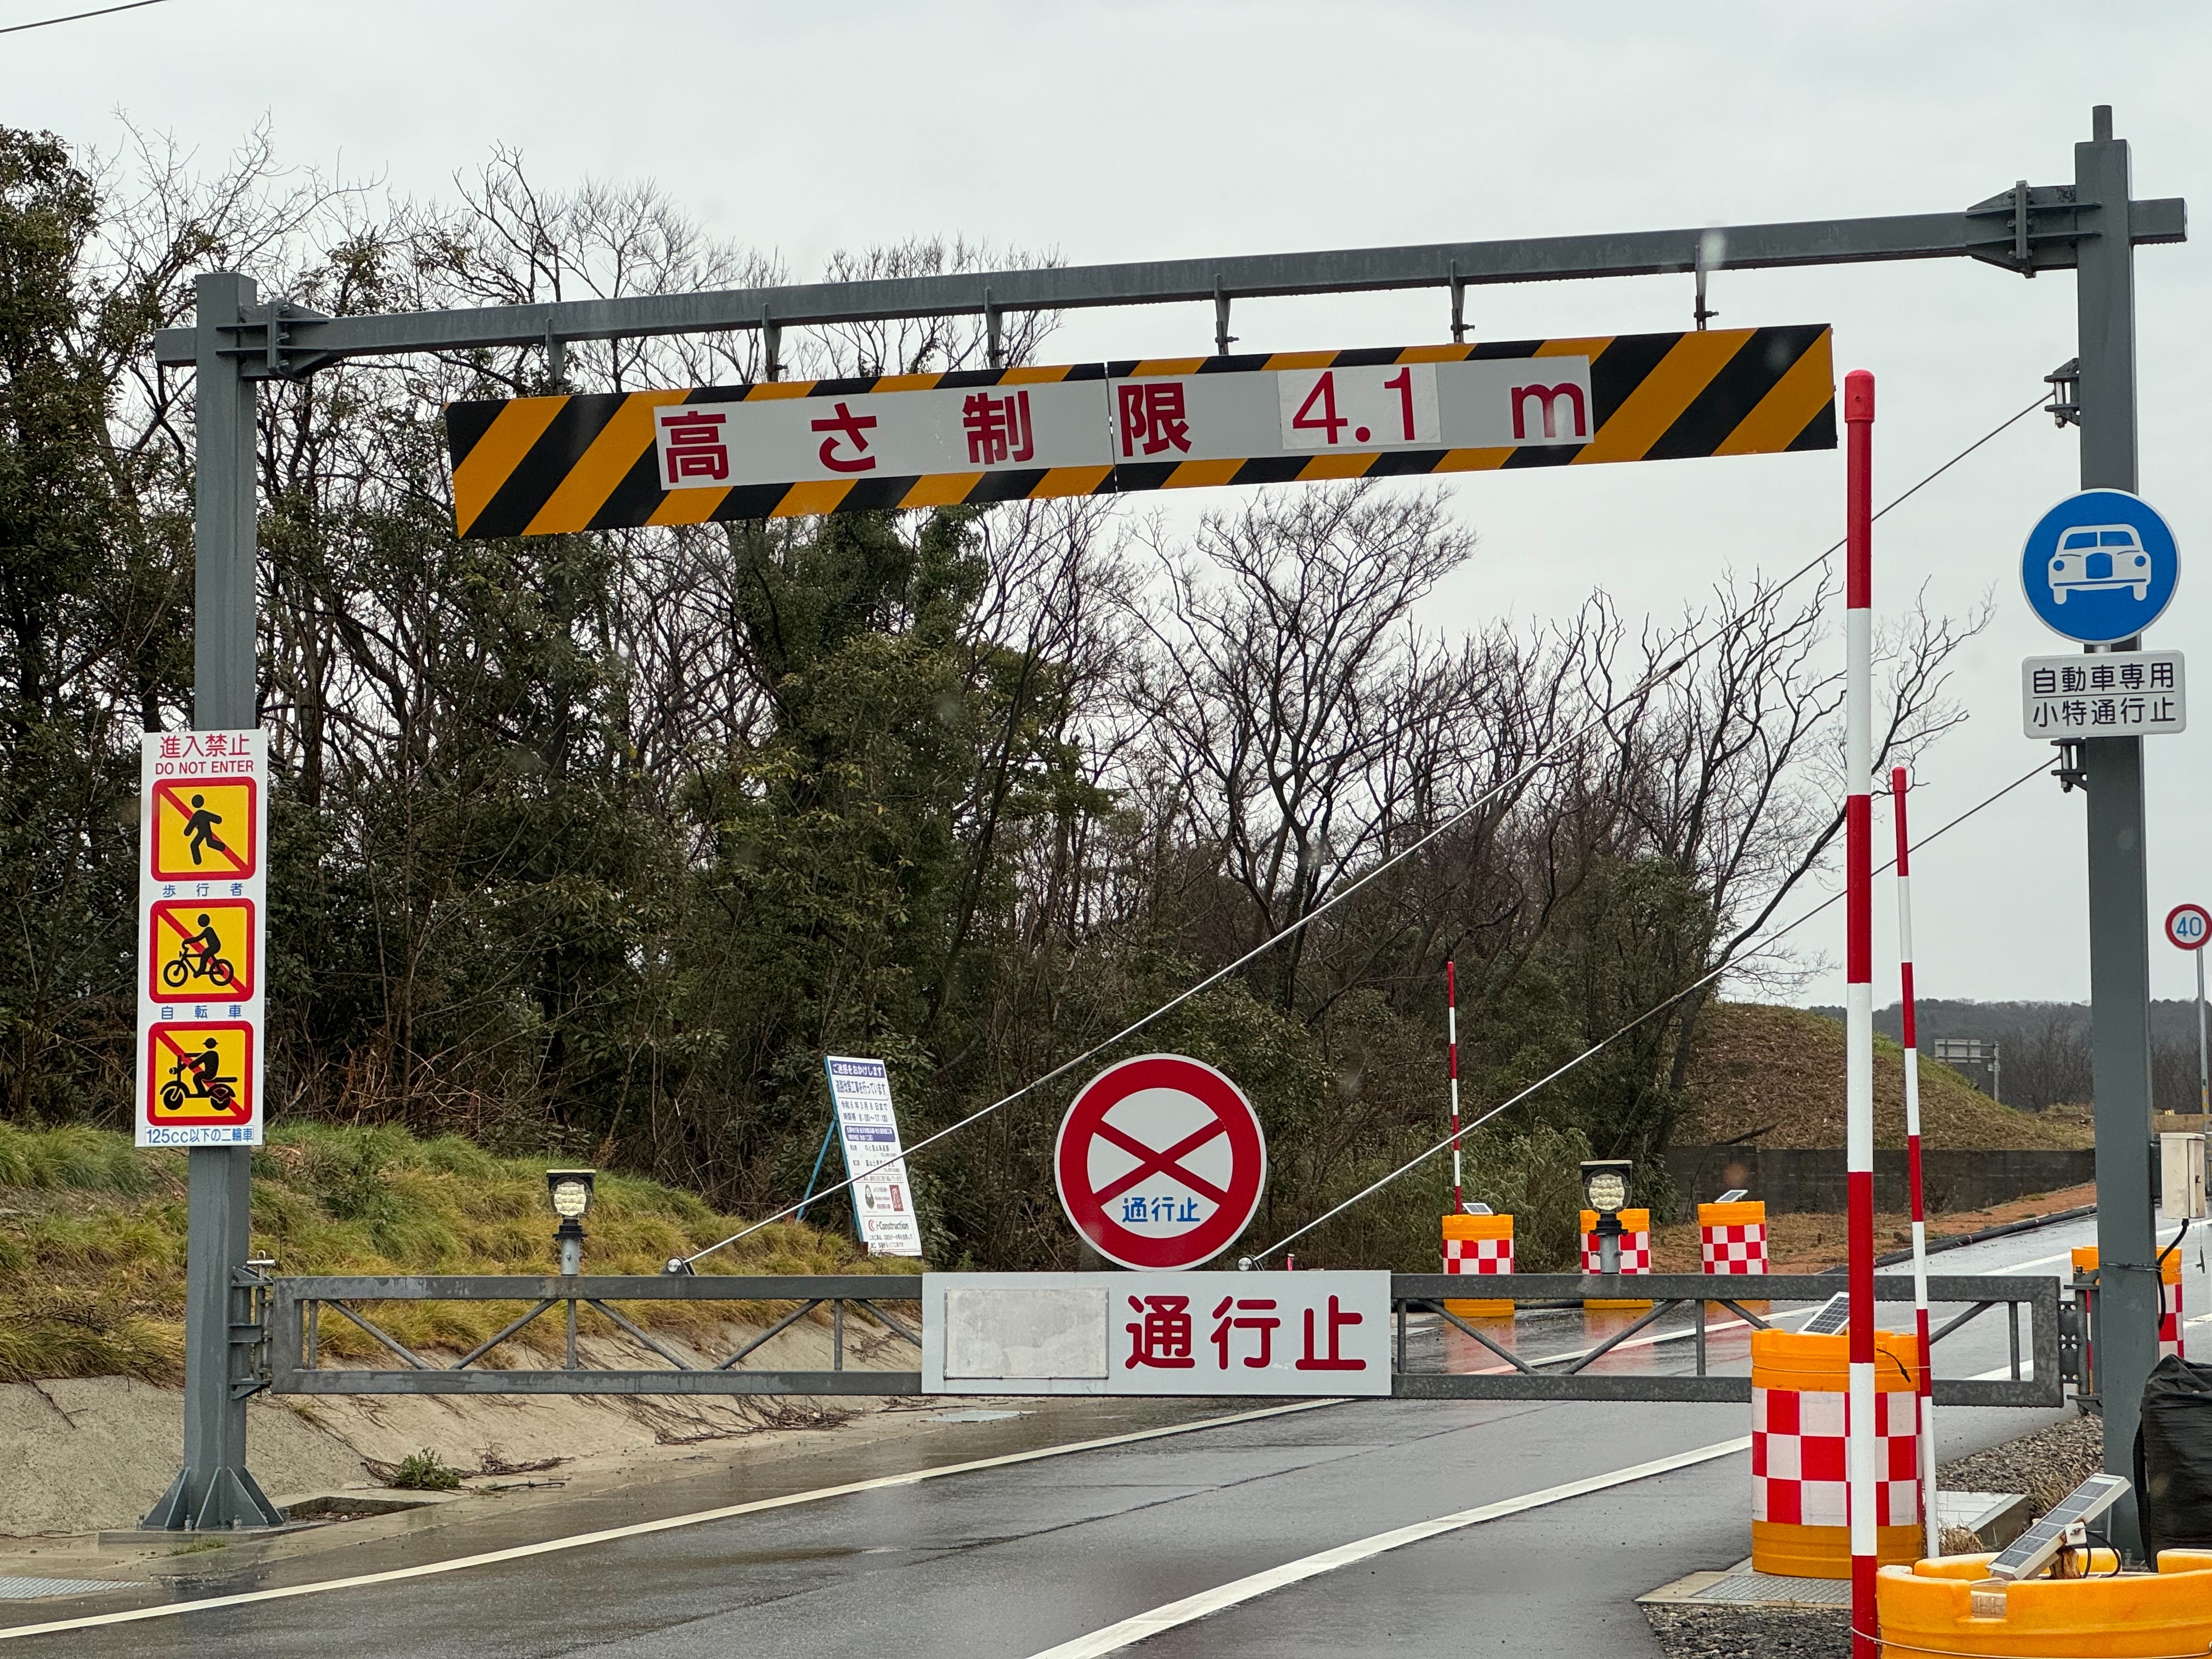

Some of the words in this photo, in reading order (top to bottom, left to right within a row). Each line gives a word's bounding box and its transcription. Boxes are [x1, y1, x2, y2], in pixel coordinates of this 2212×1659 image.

[661, 381, 1192, 484] 高さ制限
[1291, 366, 1418, 445] 4.1
[1511, 382, 1587, 438] m
[2033, 662, 2174, 694] 自動車専用
[2033, 696, 2176, 727] 小特通行止
[160, 733, 251, 759] 進入禁止
[155, 762, 174, 775] DO
[179, 761, 207, 774] NOT
[211, 760, 255, 774] ENTER
[162, 882, 244, 898] 歩行者
[2176, 916, 2202, 937] 40
[161, 1004, 242, 1019] 自転車
[146, 1127, 253, 1144] 125cc以下の二輪車
[1122, 1197, 1201, 1223] 通行止
[876, 1221, 909, 1230] i-Construction
[1125, 1295, 1367, 1371] 通行止
